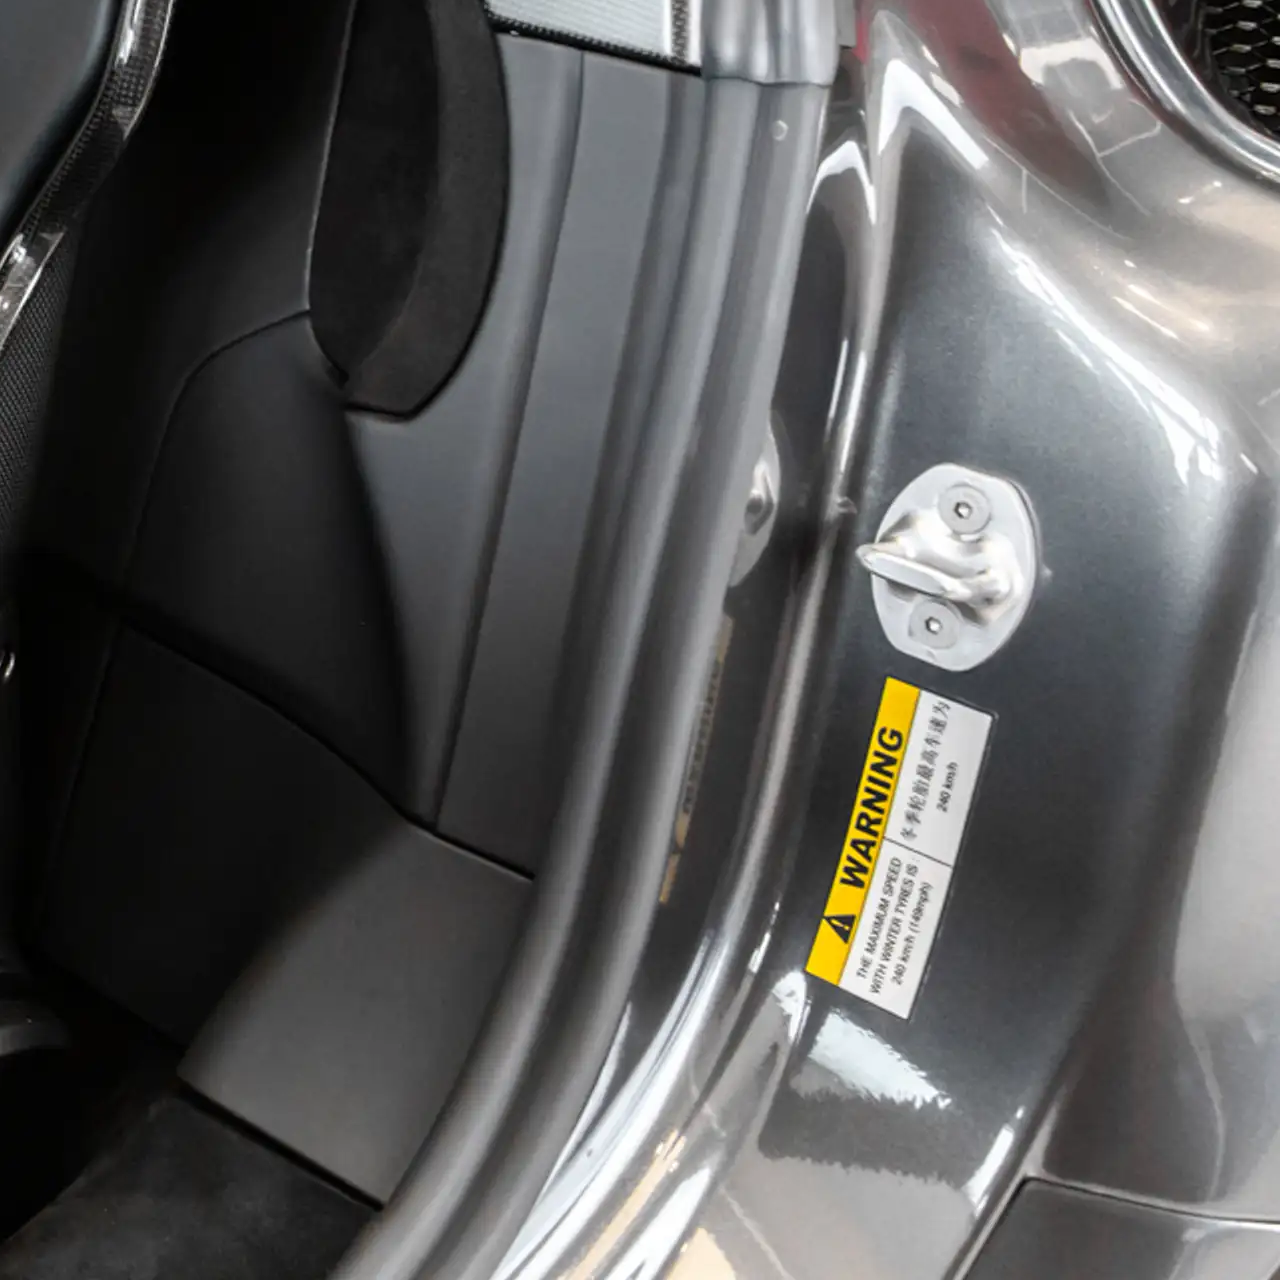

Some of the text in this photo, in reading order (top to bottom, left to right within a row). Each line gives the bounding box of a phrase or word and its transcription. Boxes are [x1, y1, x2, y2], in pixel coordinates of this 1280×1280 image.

[839, 726, 904, 890] WARNING
[937, 791, 951, 812] 240
[856, 857, 902, 978] THE MAXIMUM SPEED
[870, 964, 887, 993] WITH
[881, 917, 902, 961] WINTER
[895, 878, 915, 914] TYRES
[892, 964, 906, 985] 240
